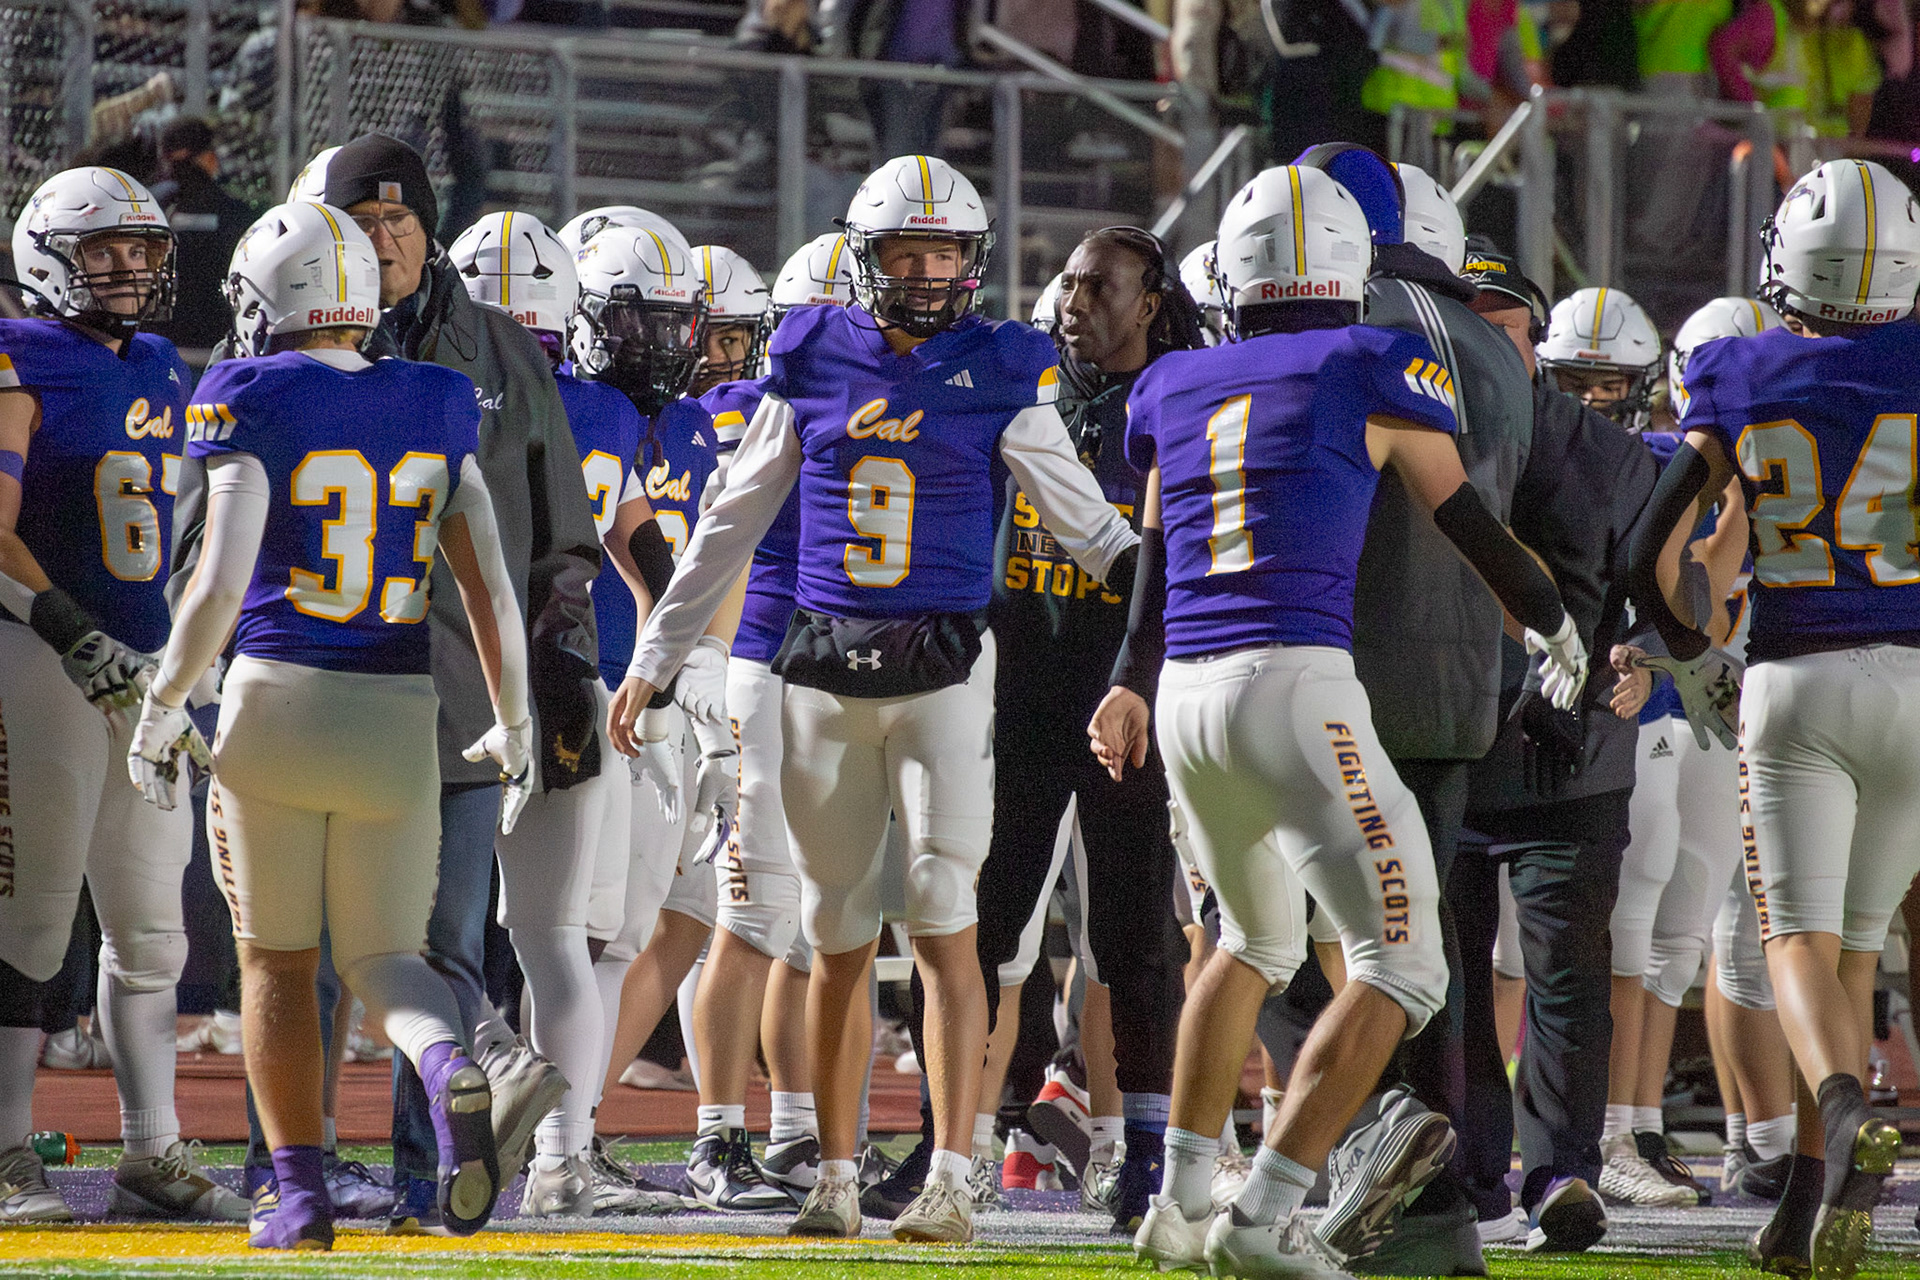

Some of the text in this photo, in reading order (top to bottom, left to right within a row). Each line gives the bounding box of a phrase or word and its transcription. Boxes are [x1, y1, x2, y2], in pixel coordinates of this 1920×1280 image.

[910, 215, 948, 225] Riddell
[1261, 280, 1340, 300] Riddell
[1819, 302, 1900, 323] Riddell
[307, 306, 374, 326] Riddell
[125, 397, 174, 440] Cal
[846, 397, 925, 443] Cal
[645, 458, 692, 502] Cal
[1205, 393, 1255, 577] 1
[1735, 413, 1920, 588] 24
[284, 449, 450, 624] 33
[843, 454, 917, 588] 9
[1323, 720, 1412, 945] FIGHTING SCOTS
